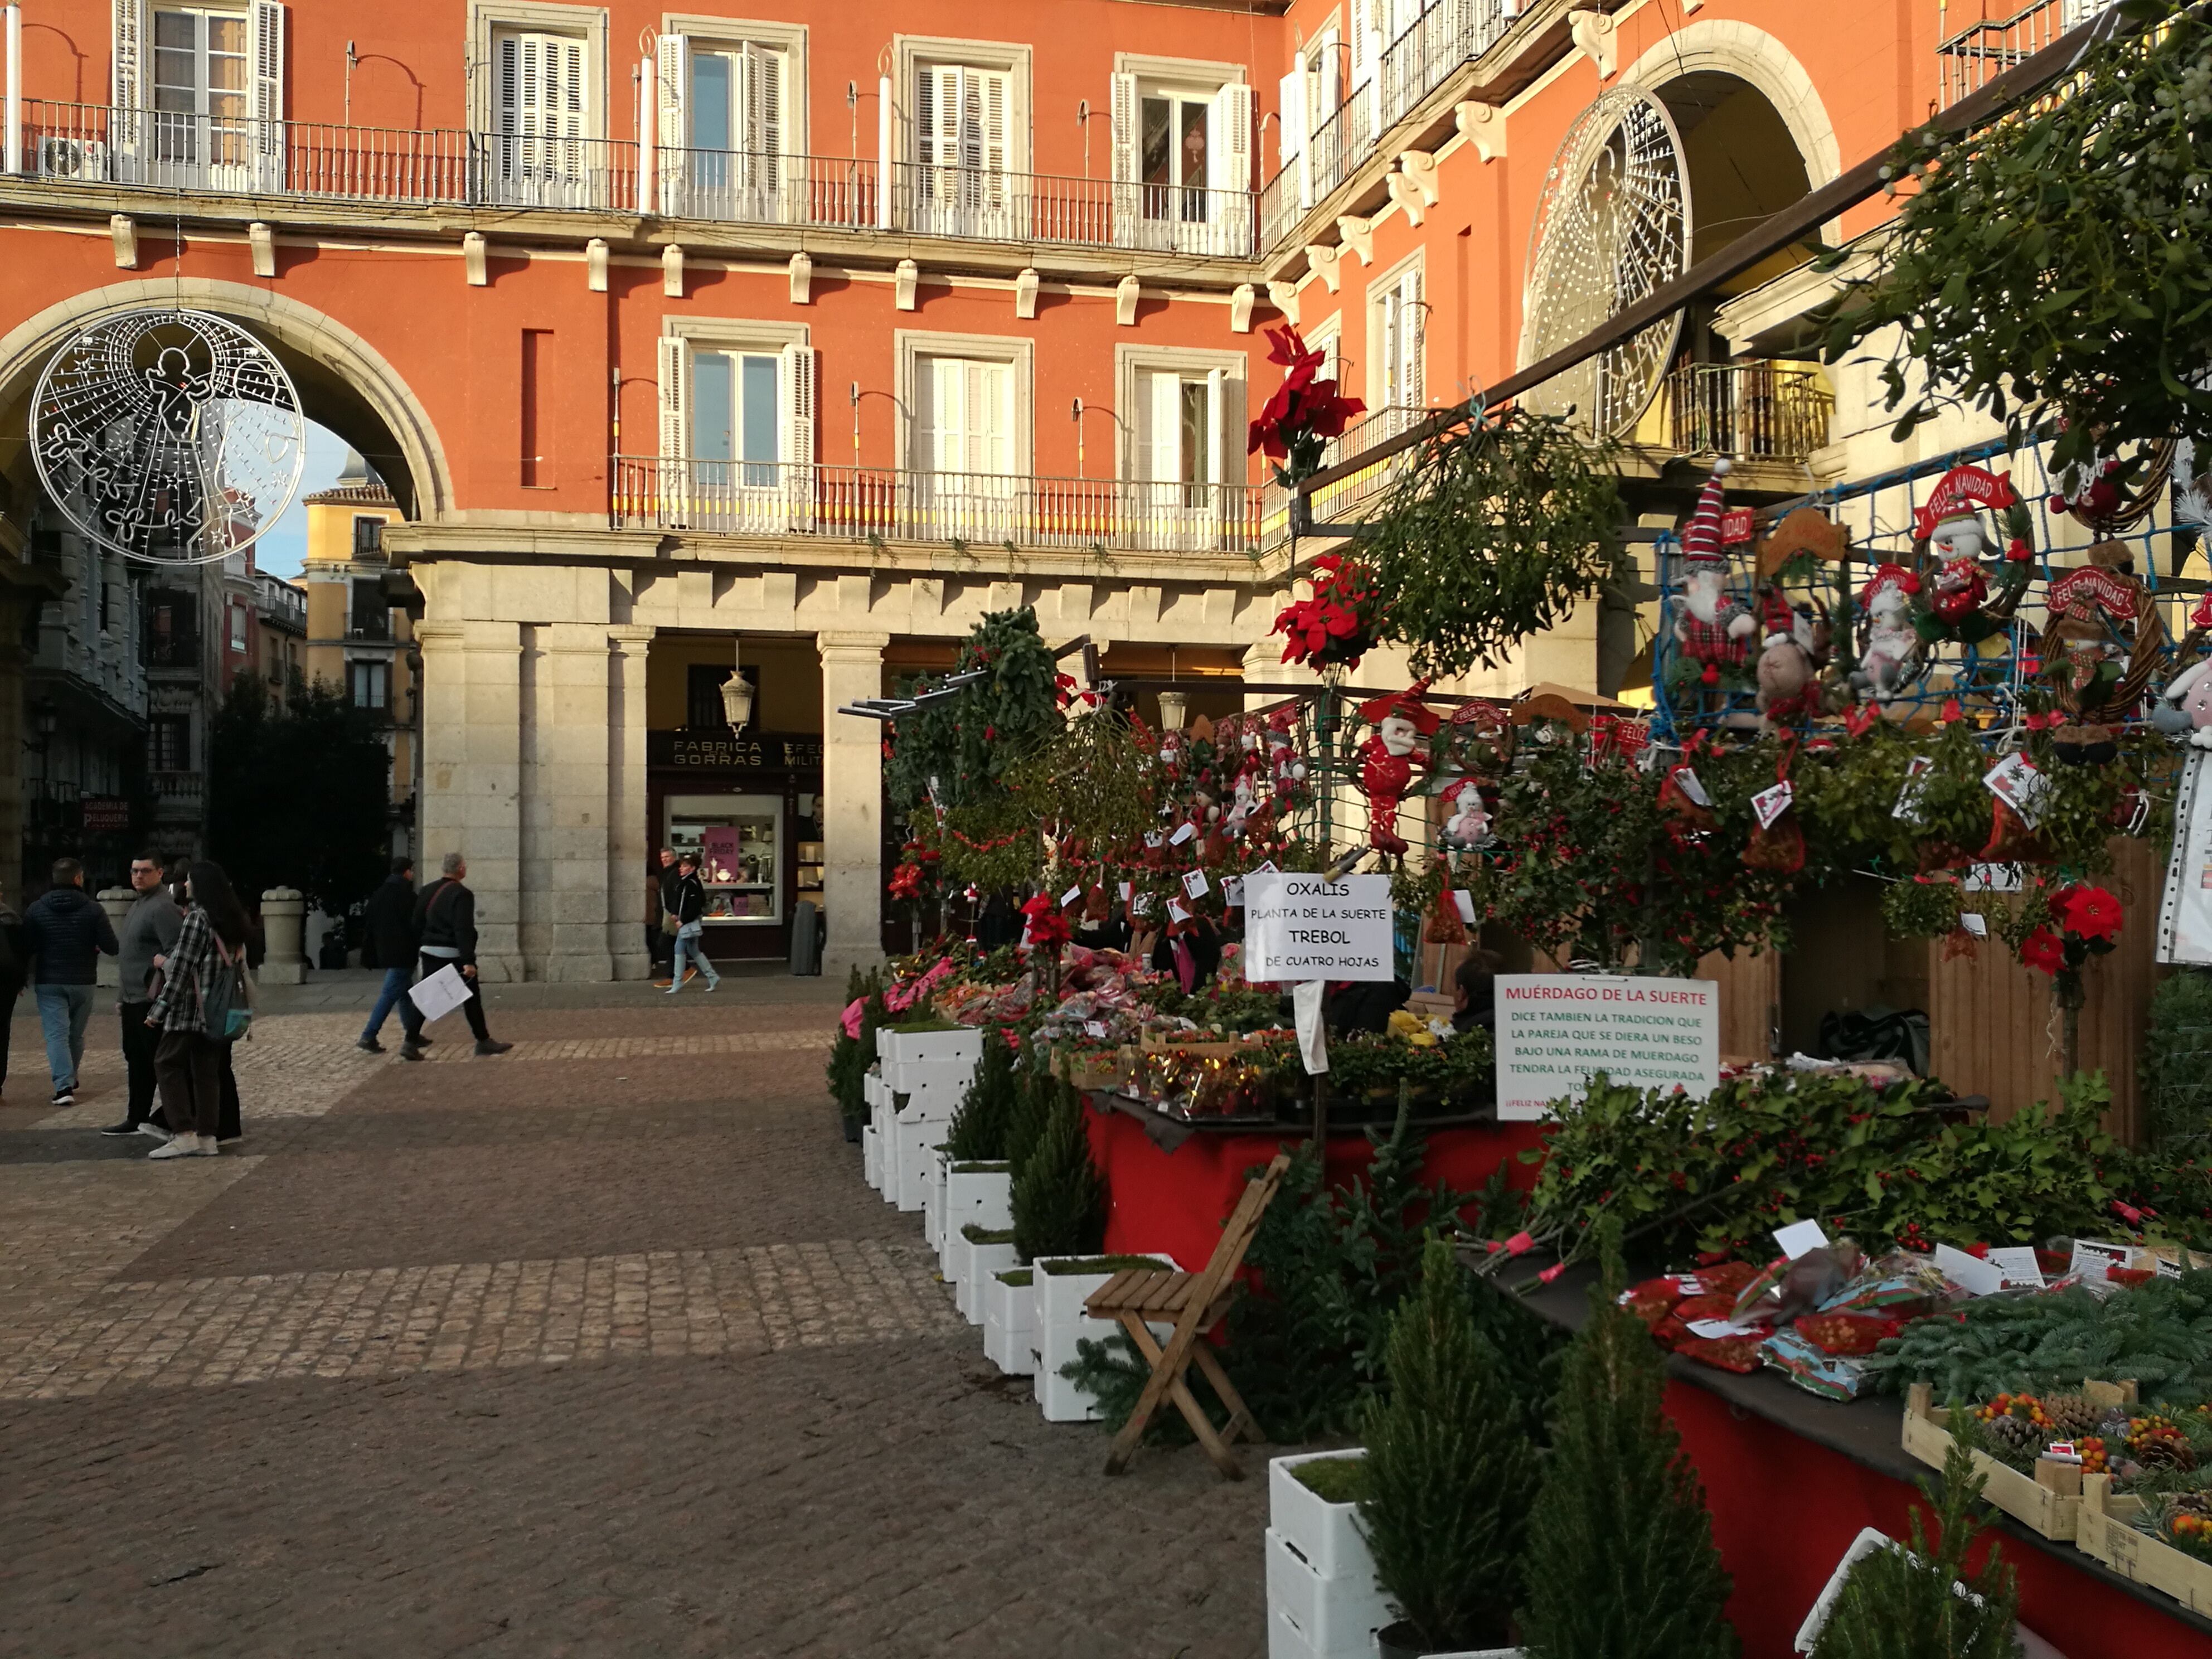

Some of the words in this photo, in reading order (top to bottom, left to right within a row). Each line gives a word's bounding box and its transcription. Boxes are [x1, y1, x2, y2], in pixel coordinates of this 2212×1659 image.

[1929, 483, 1953, 520] FELIZ
[1956, 473, 1993, 498] NAVIDAD
[1721, 517, 1747, 537] IDAD
[1459, 706, 1477, 719] FELIZ
[1621, 726, 1646, 741] FELIZ
[673, 741, 762, 752] FABRICA
[673, 755, 762, 765] GORRAS
[784, 755, 823, 766] MILIT
[85, 802, 118, 811] ACADEMIA
[119, 802, 129, 811] DE
[1287, 882, 1350, 896] OXALIS
[1251, 909, 1297, 919] PLANTA
[1303, 908, 1317, 918] DE
[1322, 909, 1336, 919] LA
[1341, 909, 1386, 919] SUERTE
[1289, 930, 1350, 944] TREBOL
[1266, 957, 1280, 966] DE
[1286, 957, 1333, 966] CUATRO
[1339, 957, 1379, 967] HOJAS
[1506, 984, 1597, 1000] MUÉRDAGO
[1603, 988, 1621, 1000] DE
[1627, 989, 1645, 1001] LA
[1650, 991, 1707, 1005] SUERTE
[1511, 1012, 1536, 1021] DICE
[1539, 1012, 1592, 1021] TAMBIEN
[1612, 1014, 1674, 1026] TRADICION
[1677, 1017, 1701, 1027] QUE
[1528, 1030, 1568, 1039] PAREJA
[1572, 1031, 1595, 1040] QUE
[1599, 1031, 1612, 1040] SE
[1615, 1032, 1648, 1041] DIERA
[1653, 1034, 1669, 1043] UN
[1673, 1035, 1702, 1045] BESO
[1515, 1047, 1542, 1055] BAJO
[1546, 1047, 1571, 1056] UNA
[1575, 1049, 1609, 1058] RAMA
[1613, 1050, 1627, 1058] DE
[1631, 1050, 1699, 1063] MUERDAGO
[1510, 1064, 1554, 1073] TENDRA
[1558, 1065, 1571, 1074] LA
[1634, 1069, 1705, 1081] ASEGURADA
